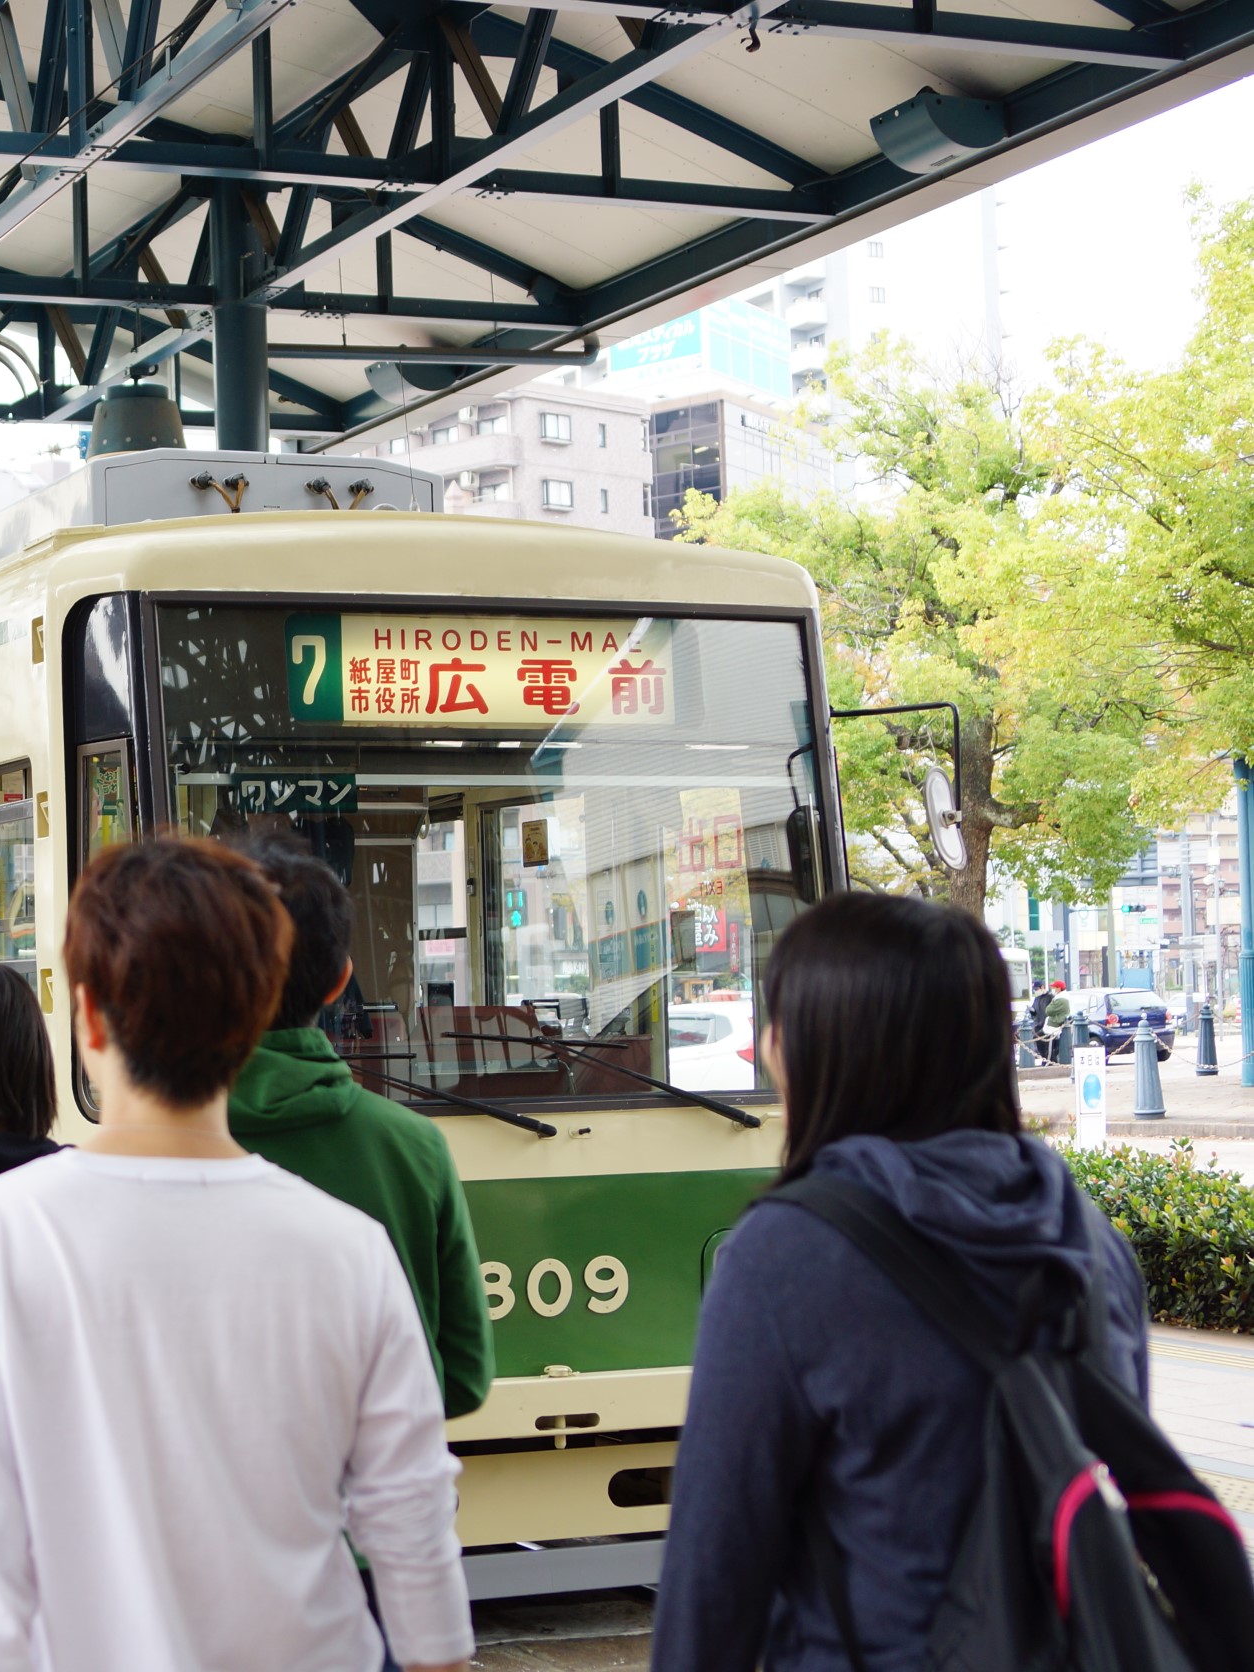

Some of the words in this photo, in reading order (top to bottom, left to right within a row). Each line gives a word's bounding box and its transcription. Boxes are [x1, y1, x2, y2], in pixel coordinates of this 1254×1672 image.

[374, 628, 643, 654] HIRODEN-MAE
[292, 635, 327, 706] 7
[349, 657, 421, 685] 紙屋町
[349, 686, 421, 715] 市役所
[425, 657, 668, 716] 広電前
